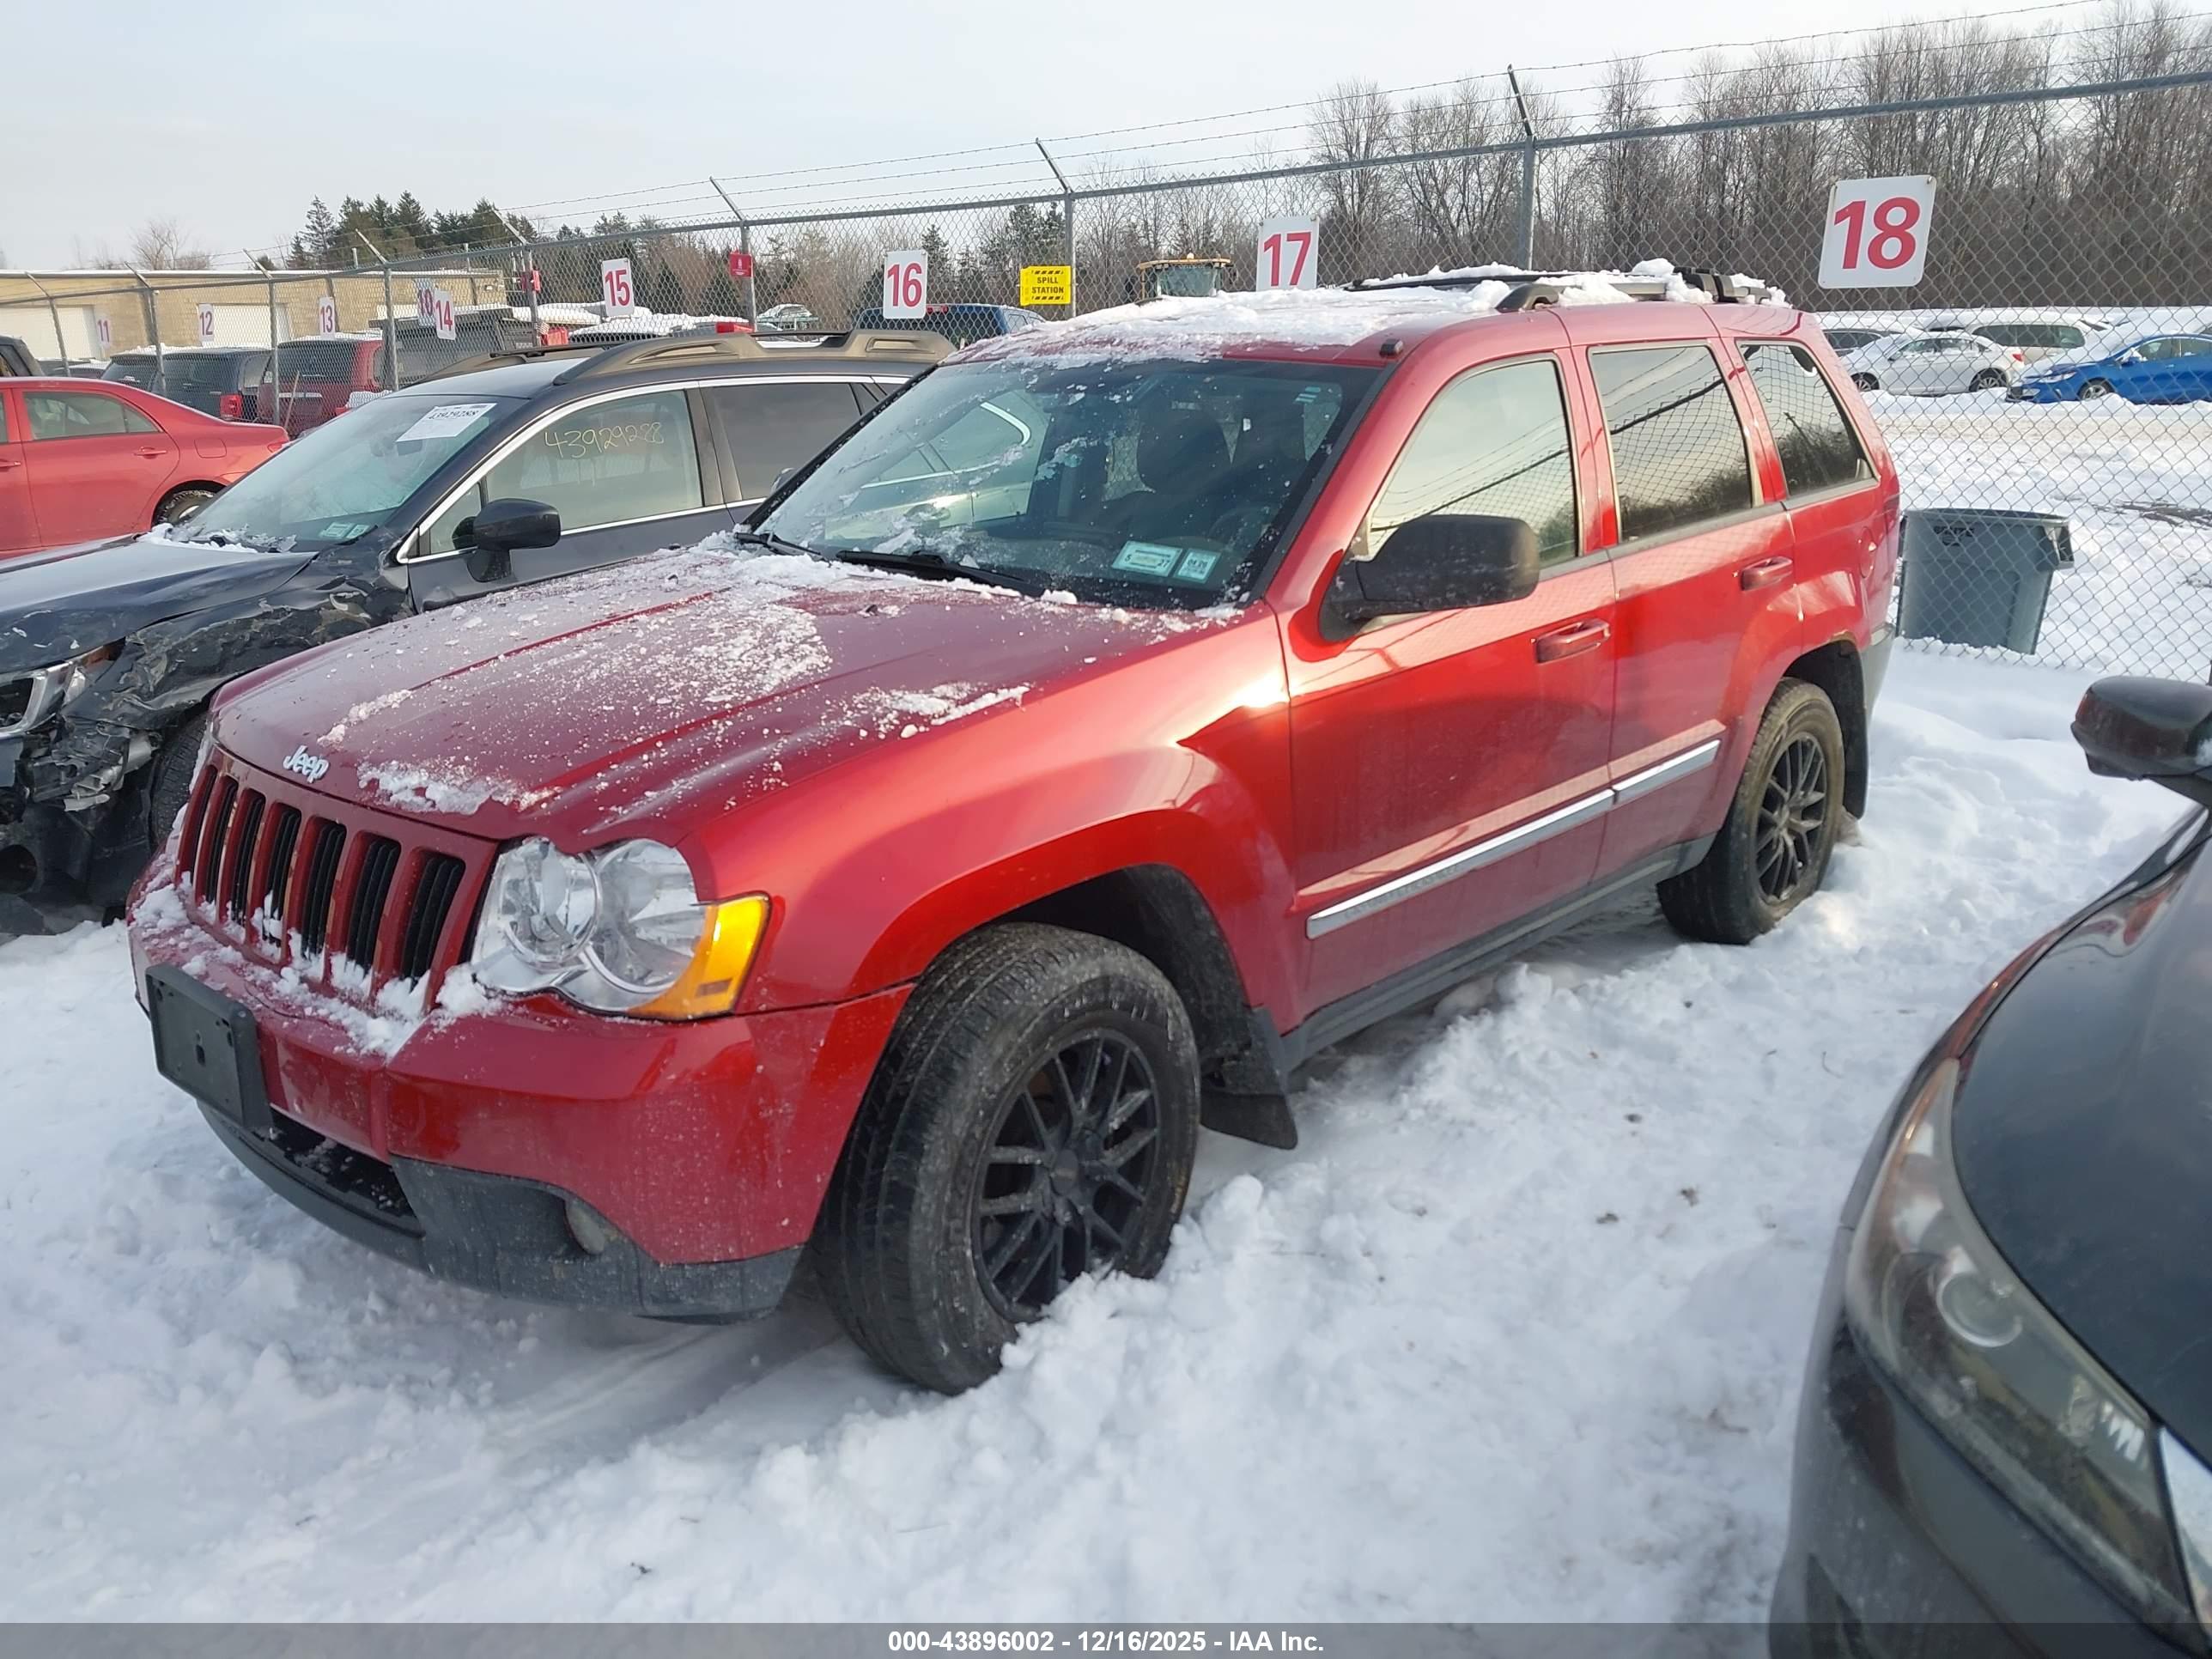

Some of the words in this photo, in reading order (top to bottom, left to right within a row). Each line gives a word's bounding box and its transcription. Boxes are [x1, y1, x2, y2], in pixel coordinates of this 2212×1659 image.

[1834, 197, 1921, 270] 18
[1263, 231, 1312, 287] 17
[605, 269, 630, 307] 15
[887, 262, 923, 307] 16
[1031, 286, 1065, 295] STATION
[1036, 276, 1059, 284] SPILL
[97, 319, 110, 343] 11
[199, 310, 213, 337] 12
[319, 305, 333, 333] 13
[435, 300, 453, 331] 14
[283, 744, 330, 784] Jeep
